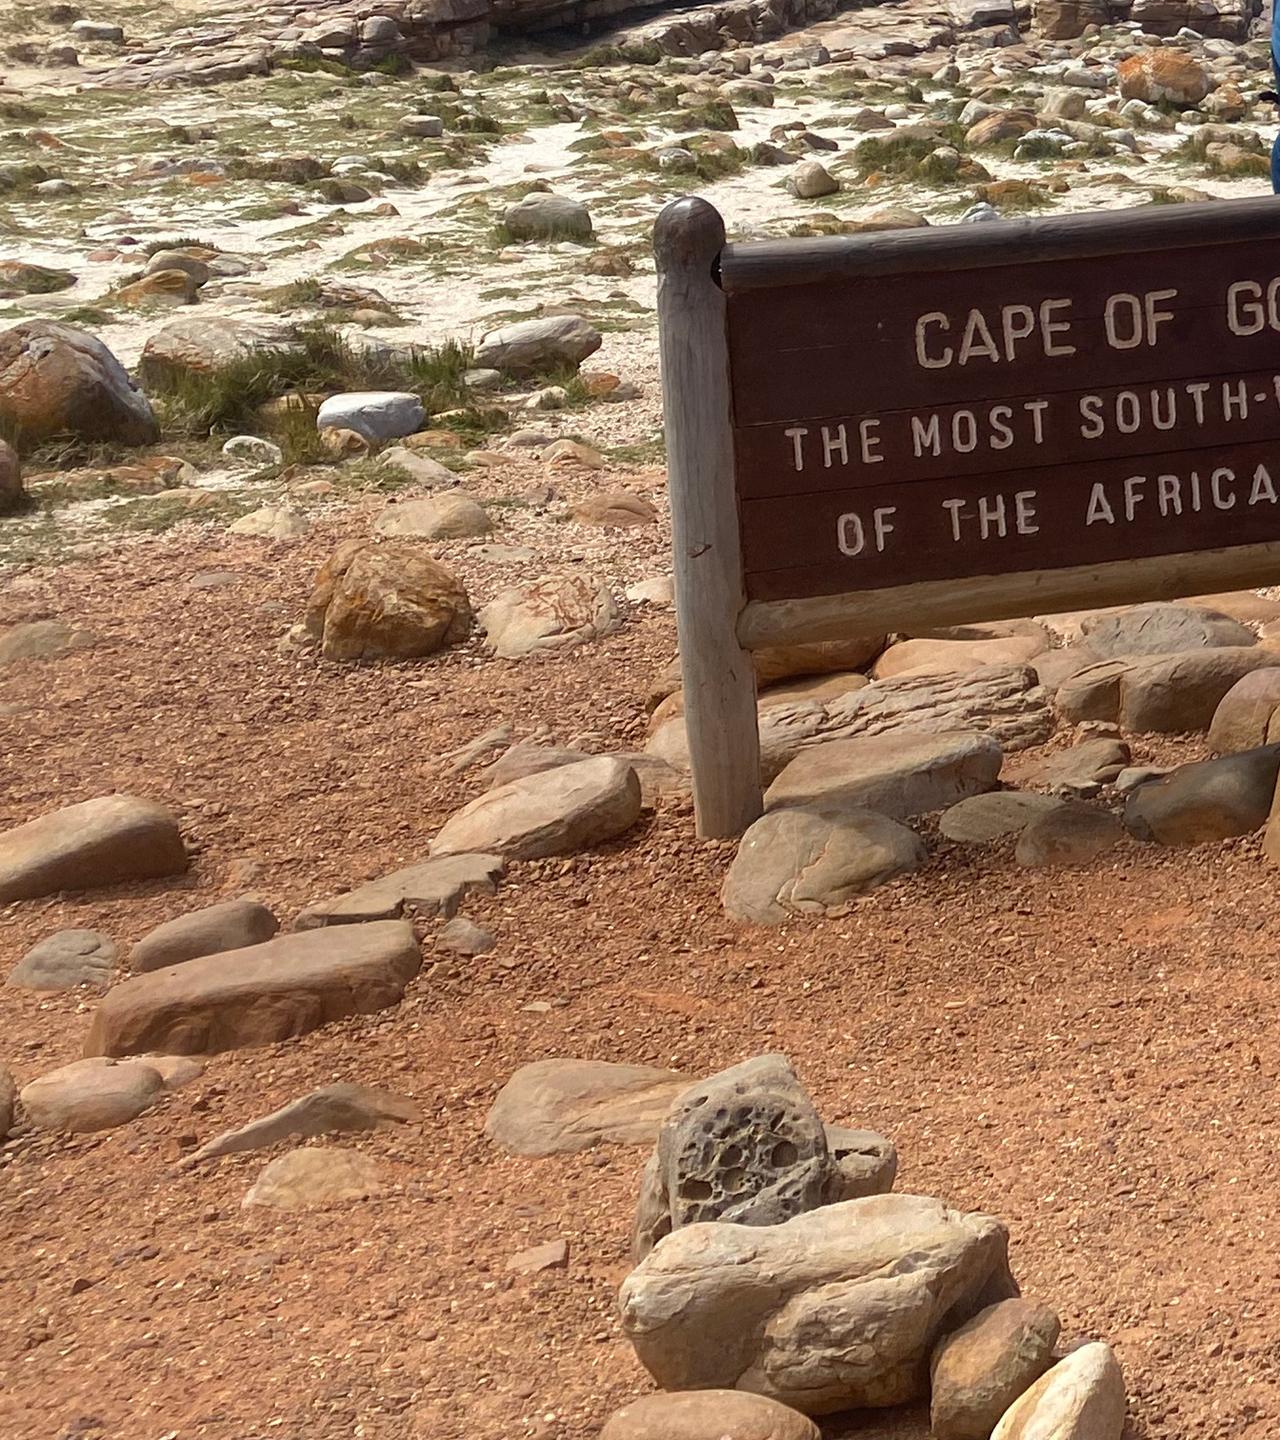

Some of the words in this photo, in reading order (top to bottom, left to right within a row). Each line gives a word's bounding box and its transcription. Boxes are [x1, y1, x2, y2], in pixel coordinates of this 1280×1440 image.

[915, 299, 1078, 371] CAPE
[1102, 289, 1178, 350] OF
[784, 418, 886, 473] THE
[910, 399, 1049, 458] MOST
[836, 505, 897, 557] OF
[942, 491, 1041, 543] THE
